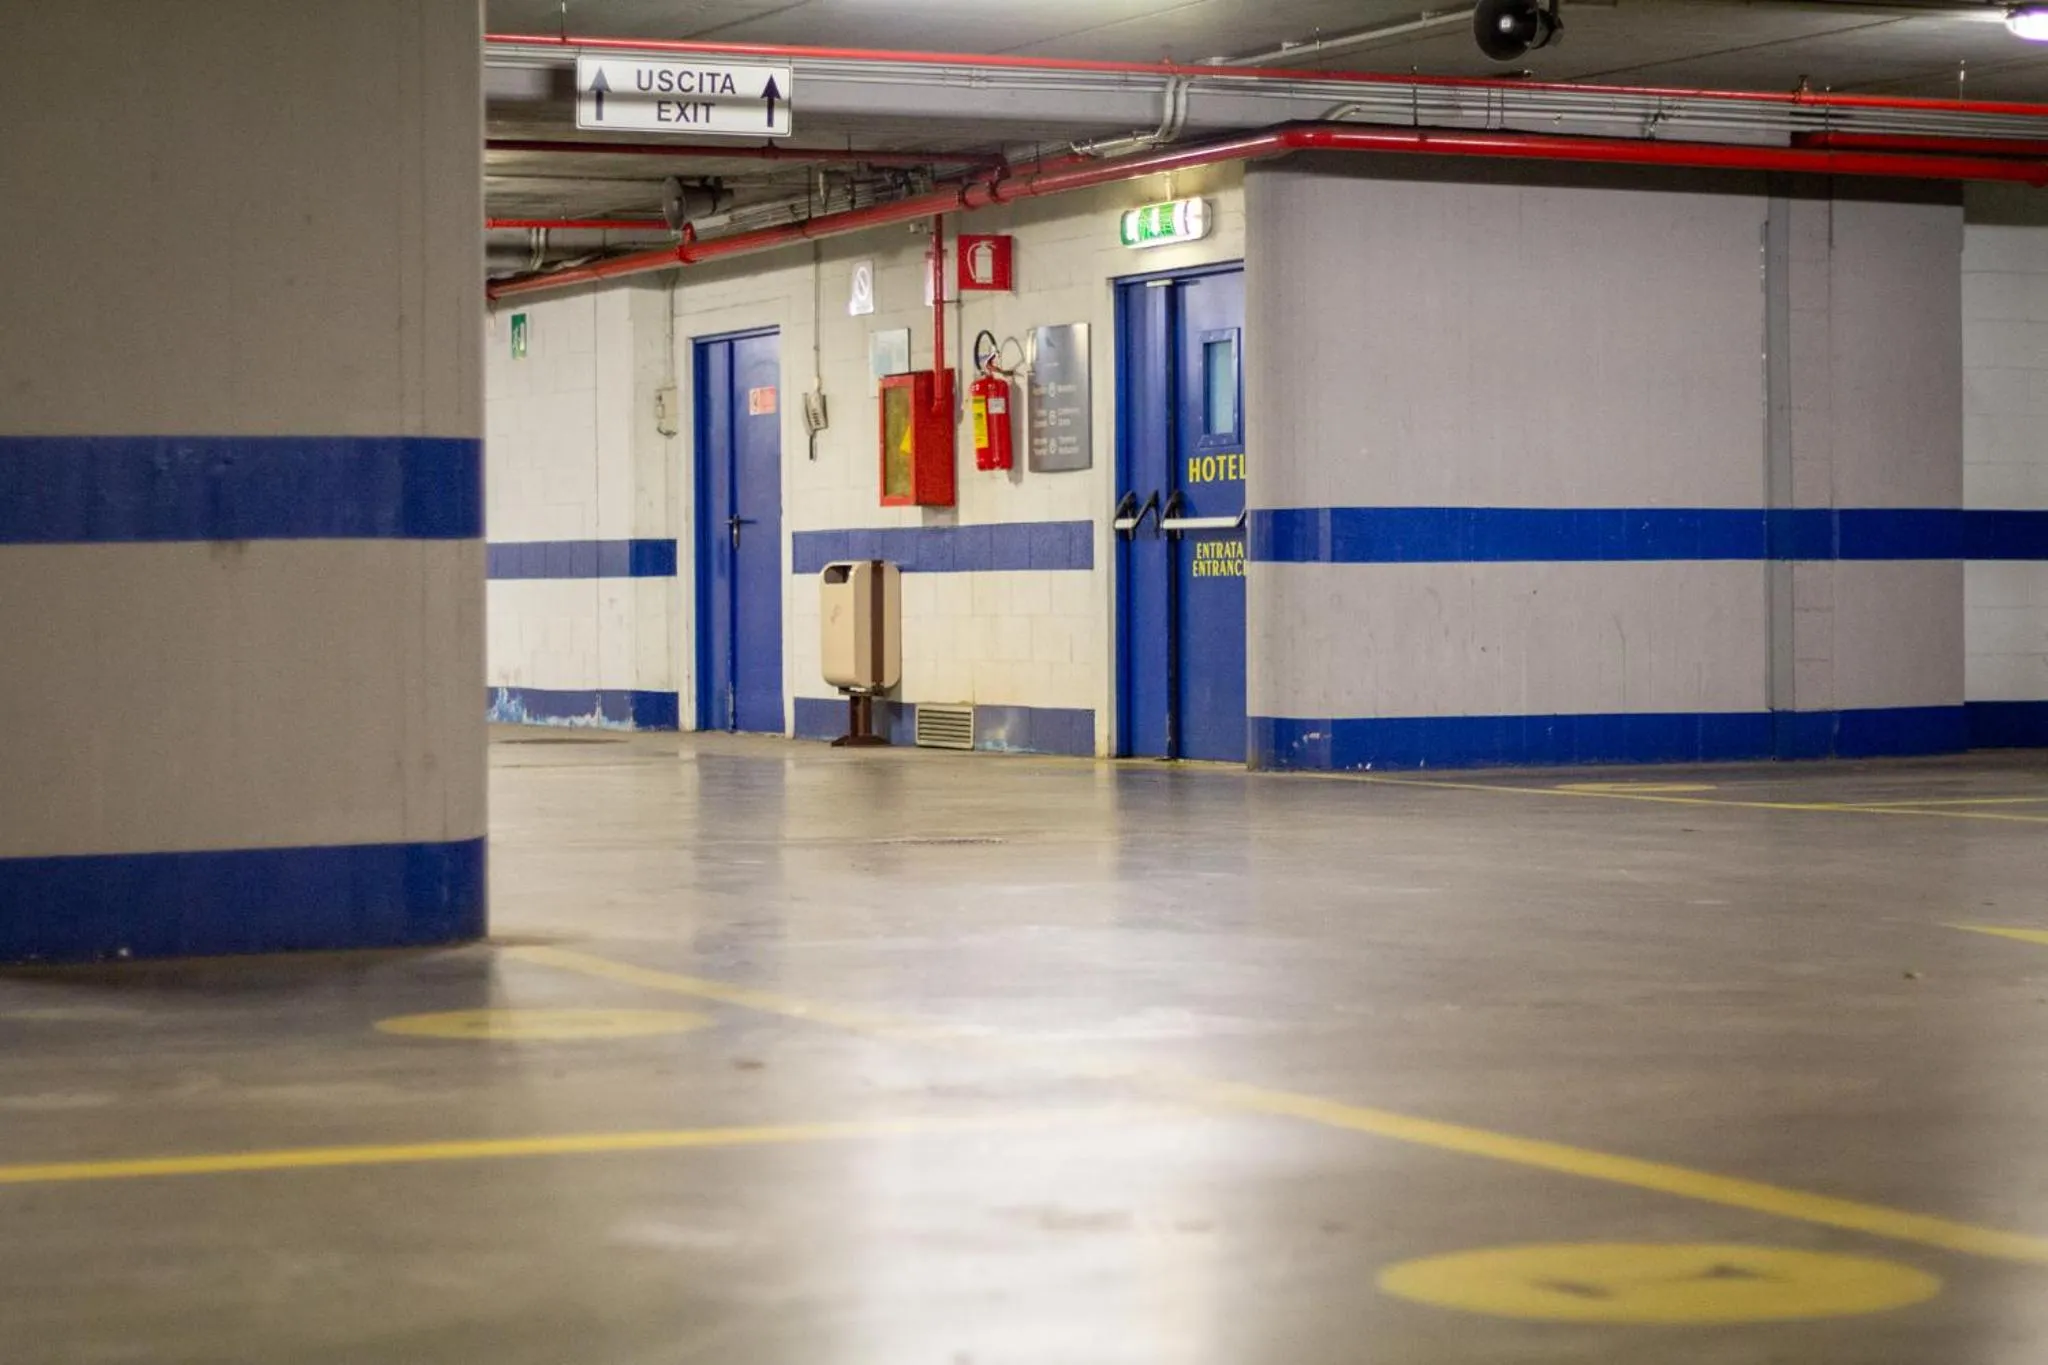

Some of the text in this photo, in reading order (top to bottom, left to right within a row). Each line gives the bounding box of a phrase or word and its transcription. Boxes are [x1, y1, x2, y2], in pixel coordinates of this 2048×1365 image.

[636, 69, 736, 94] USCITA
[657, 100, 716, 123] EXIT
[1188, 454, 1246, 482] HOTEL
[1196, 541, 1244, 559] ENTRATA
